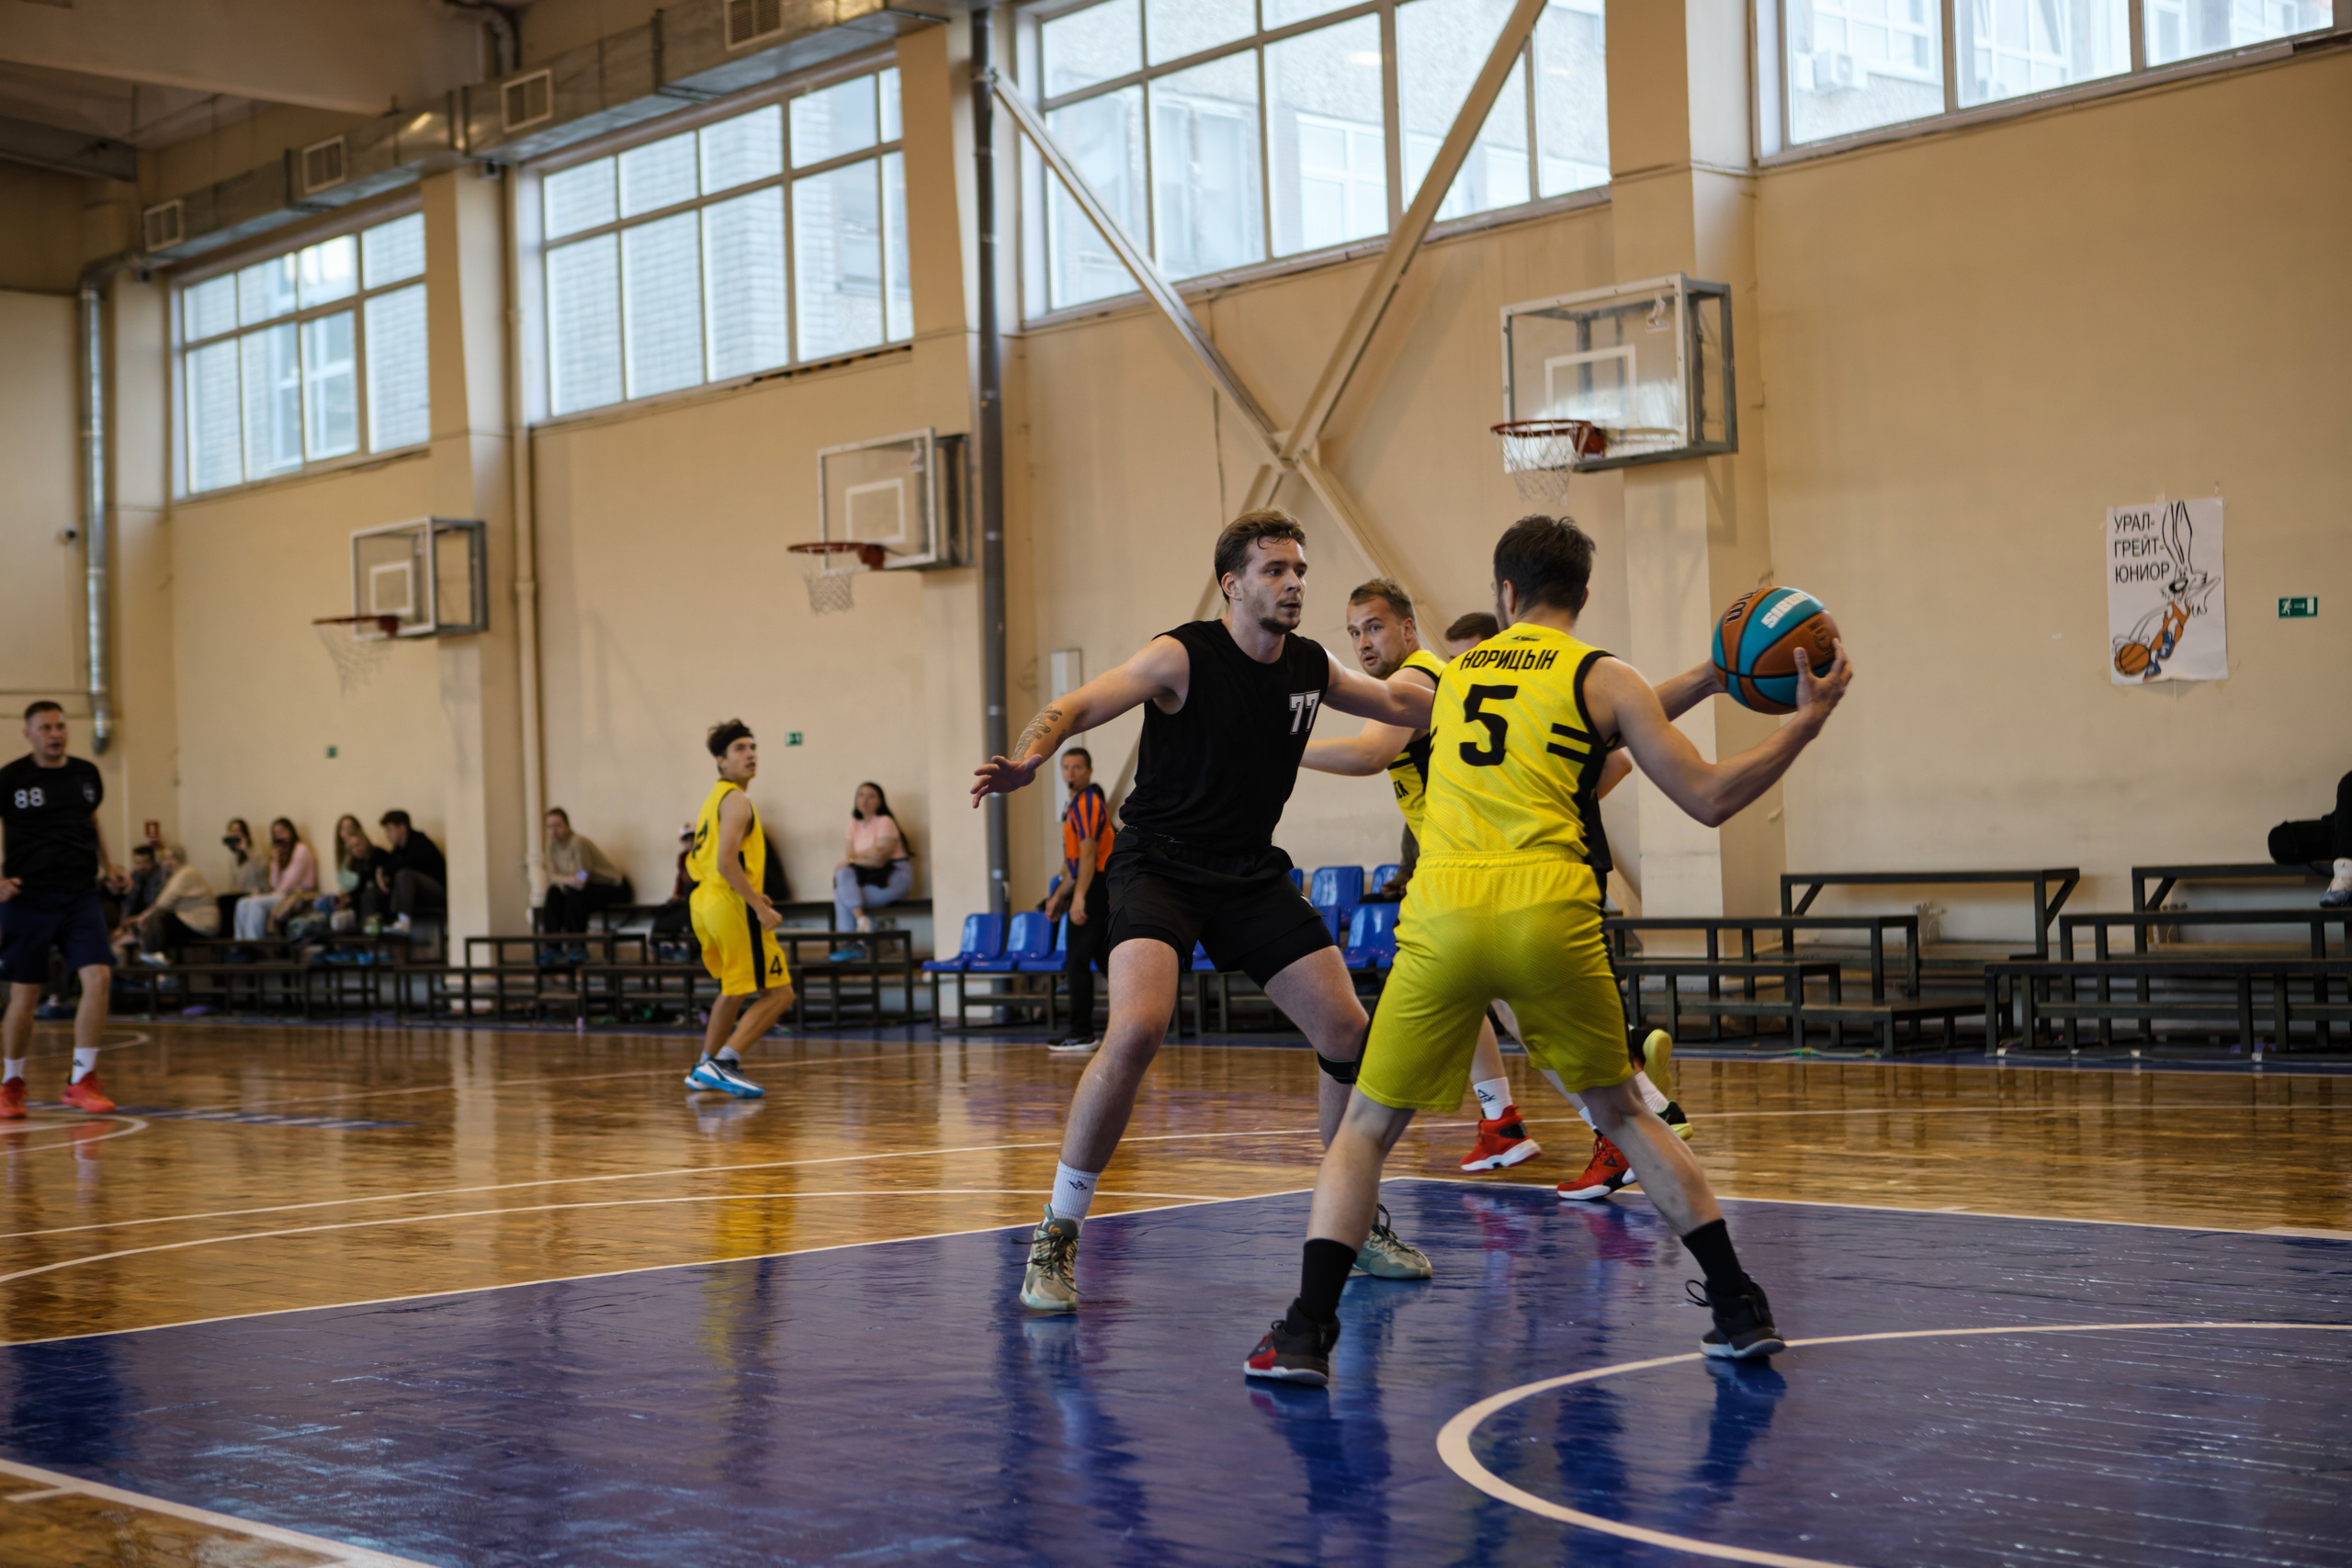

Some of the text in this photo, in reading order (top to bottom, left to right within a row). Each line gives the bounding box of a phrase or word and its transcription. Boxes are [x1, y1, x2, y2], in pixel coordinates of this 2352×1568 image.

[2115, 561, 2170, 584] ЮНИОР
[1459, 649, 1559, 671] НОРИЦЫН
[1289, 690, 1320, 735] 77
[1459, 683, 1518, 766] 5
[14, 787, 44, 808] 88
[769, 955, 783, 976] 4
